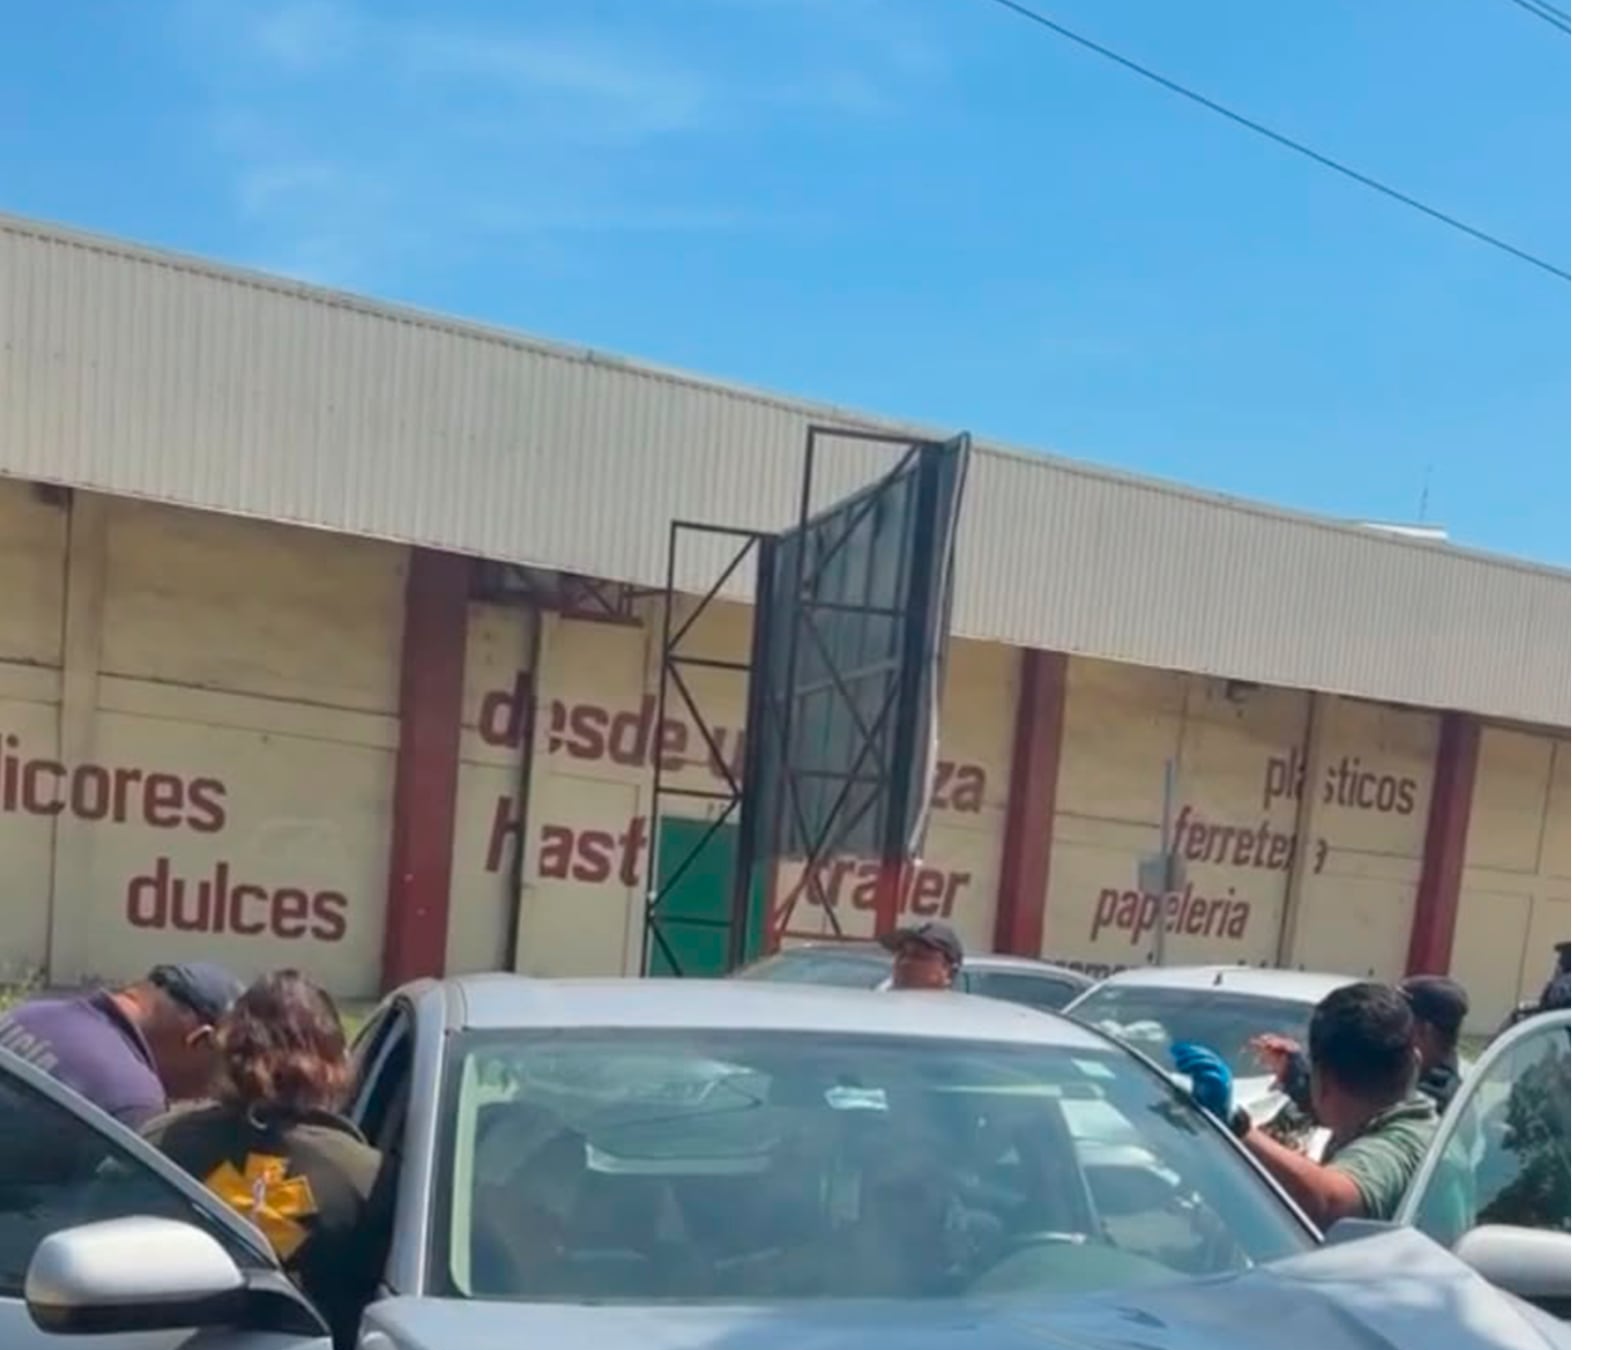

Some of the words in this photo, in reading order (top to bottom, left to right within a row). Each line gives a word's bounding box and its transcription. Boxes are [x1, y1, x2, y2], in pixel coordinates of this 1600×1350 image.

[0, 732, 227, 834] icores
[126, 856, 349, 943] dulces
[803, 850, 971, 919] traler
